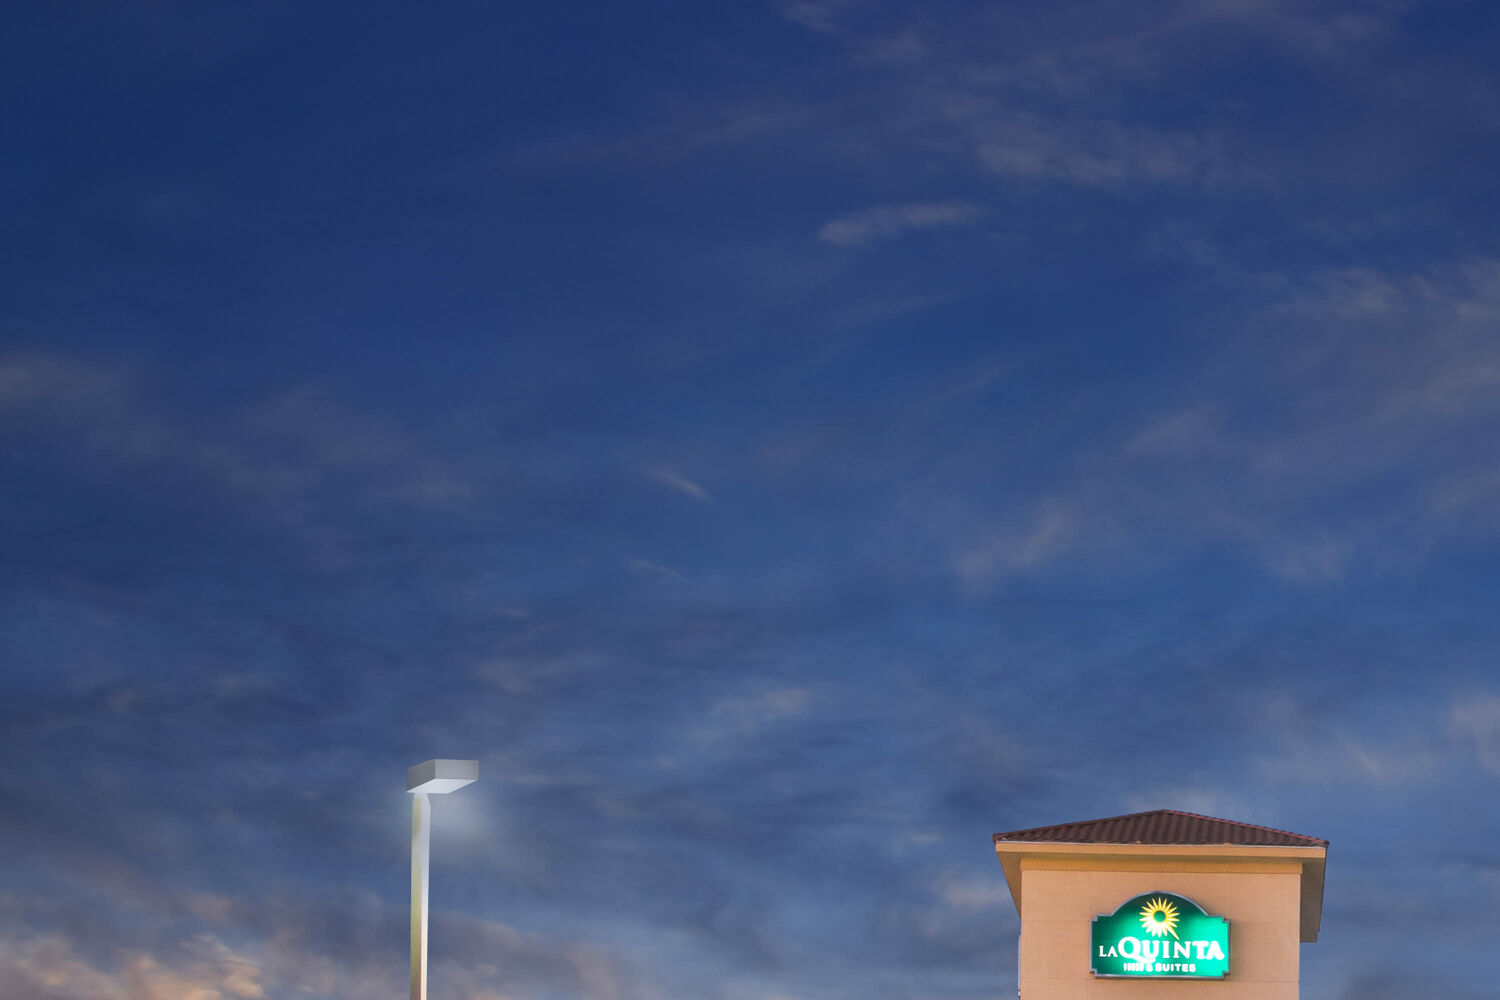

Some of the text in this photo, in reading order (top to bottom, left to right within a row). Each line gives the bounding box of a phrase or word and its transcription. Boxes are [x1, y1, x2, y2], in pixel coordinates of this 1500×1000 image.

[1098, 936, 1225, 964] LA QUINTA
[1155, 962, 1197, 973] SUITES
